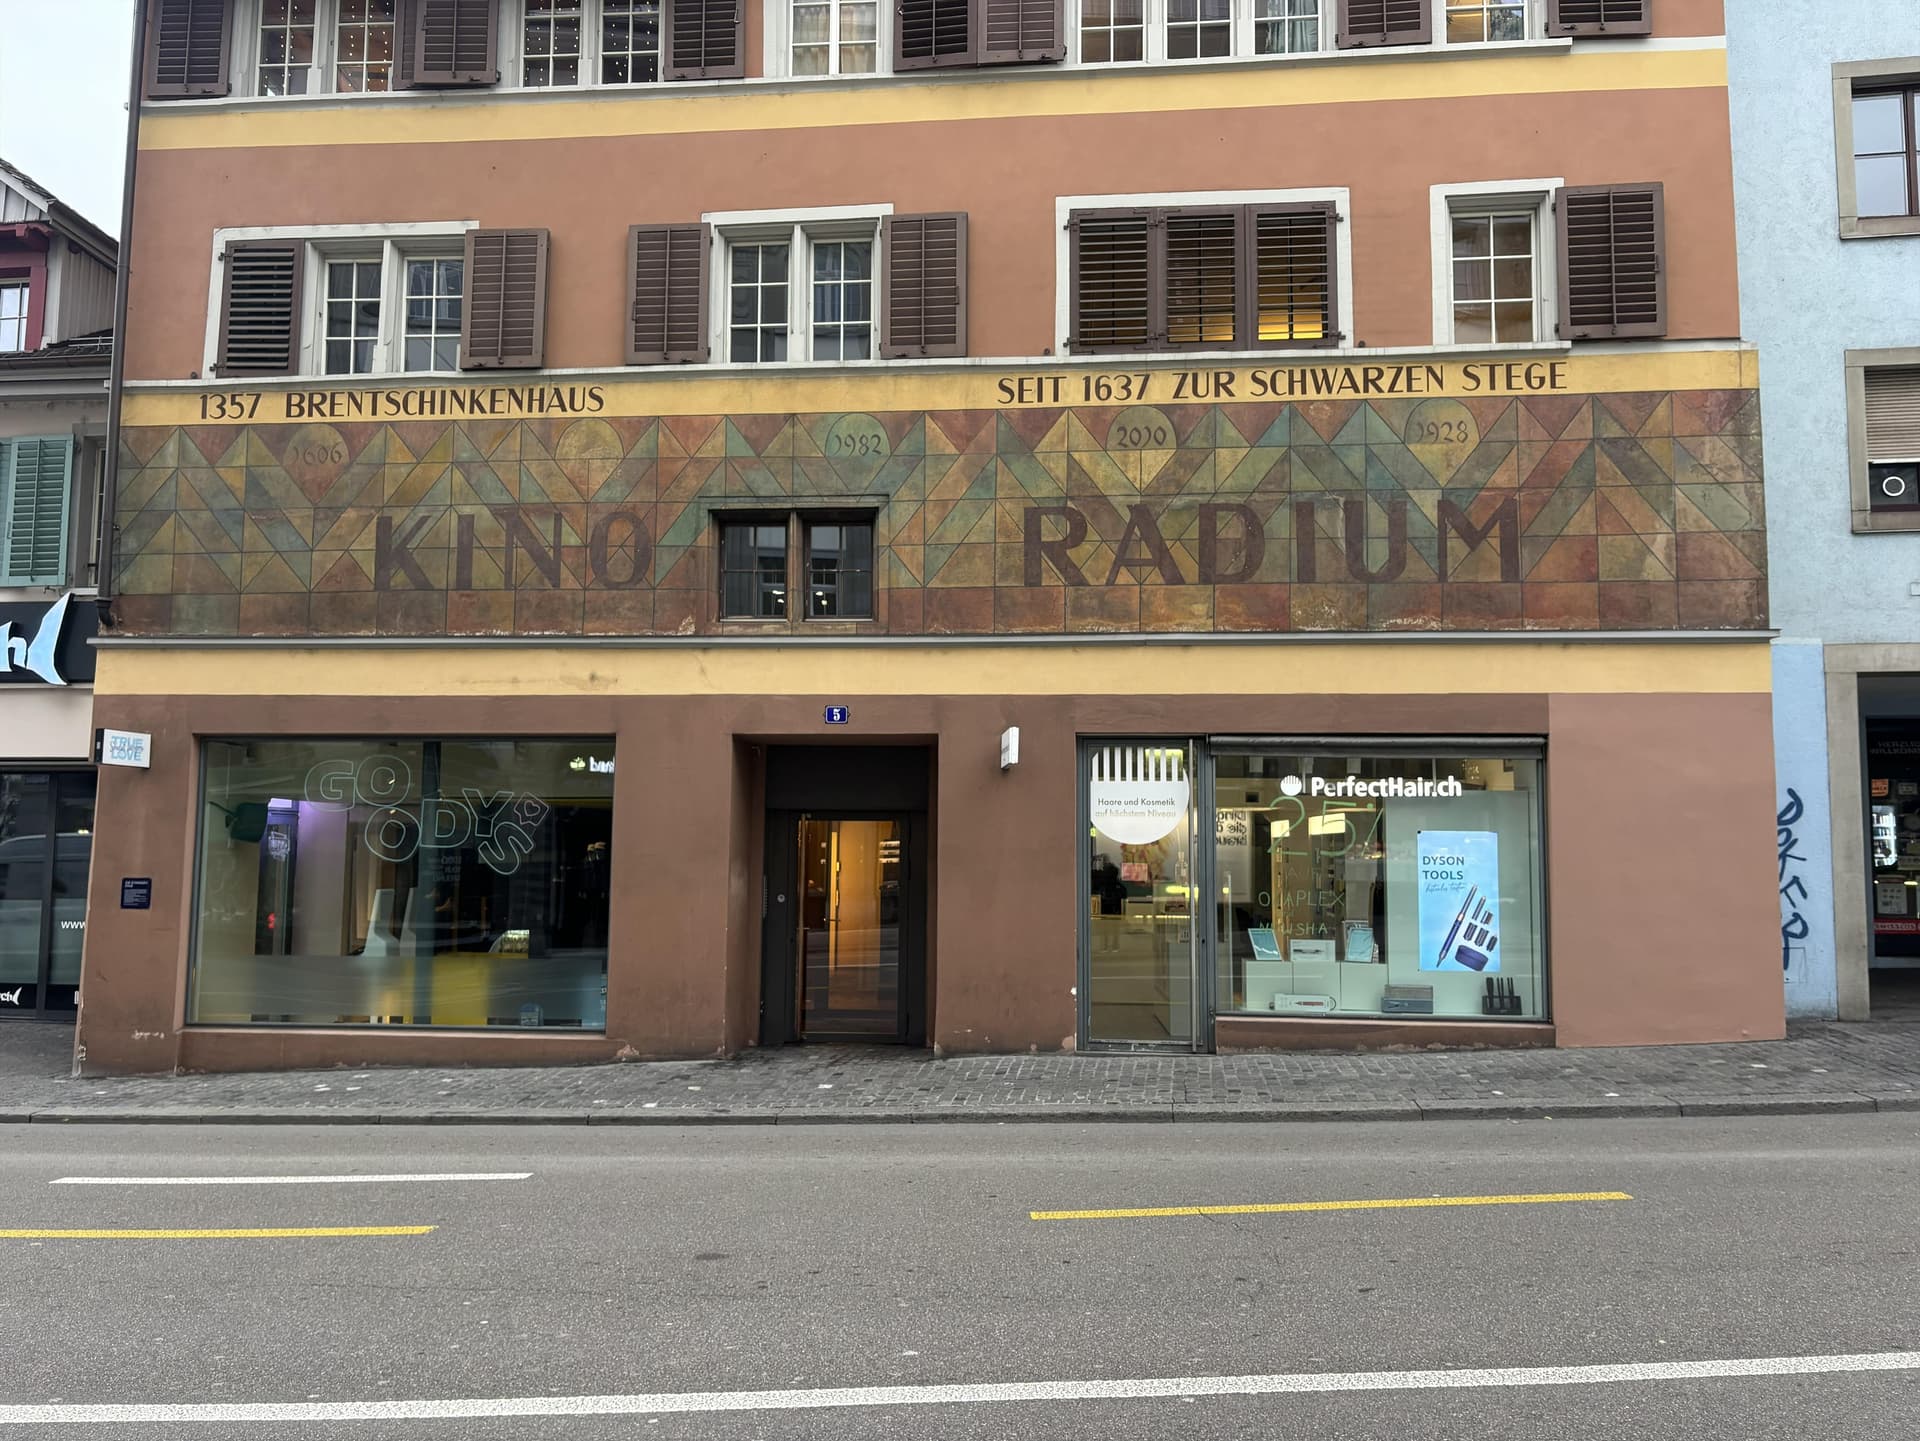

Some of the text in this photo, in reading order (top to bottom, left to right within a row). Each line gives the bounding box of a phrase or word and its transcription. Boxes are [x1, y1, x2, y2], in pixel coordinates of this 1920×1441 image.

[997, 361, 1568, 405] SEIT 1637 ZUR SCHWARZEN STEGE
[200, 386, 605, 420] 1357 BRENTSCHINKENHAUS
[1116, 425, 1167, 449] 2010
[1415, 420, 1469, 444] 1928
[291, 441, 343, 465] 1606
[834, 433, 883, 457] 1982
[374, 509, 653, 591] KINO
[1023, 493, 1521, 587] RADIUM
[832, 708, 841, 721] 5
[111, 749, 143, 760] LOVE
[1311, 775, 1462, 798] PerfectHair.ch
[1095, 808, 1108, 817] auf
[1147, 808, 1176, 817] Niveau
[1098, 797, 1176, 806] Haare und Kosmetik
[1422, 855, 1465, 866] DYSON
[1422, 870, 1464, 880] TOOLS
